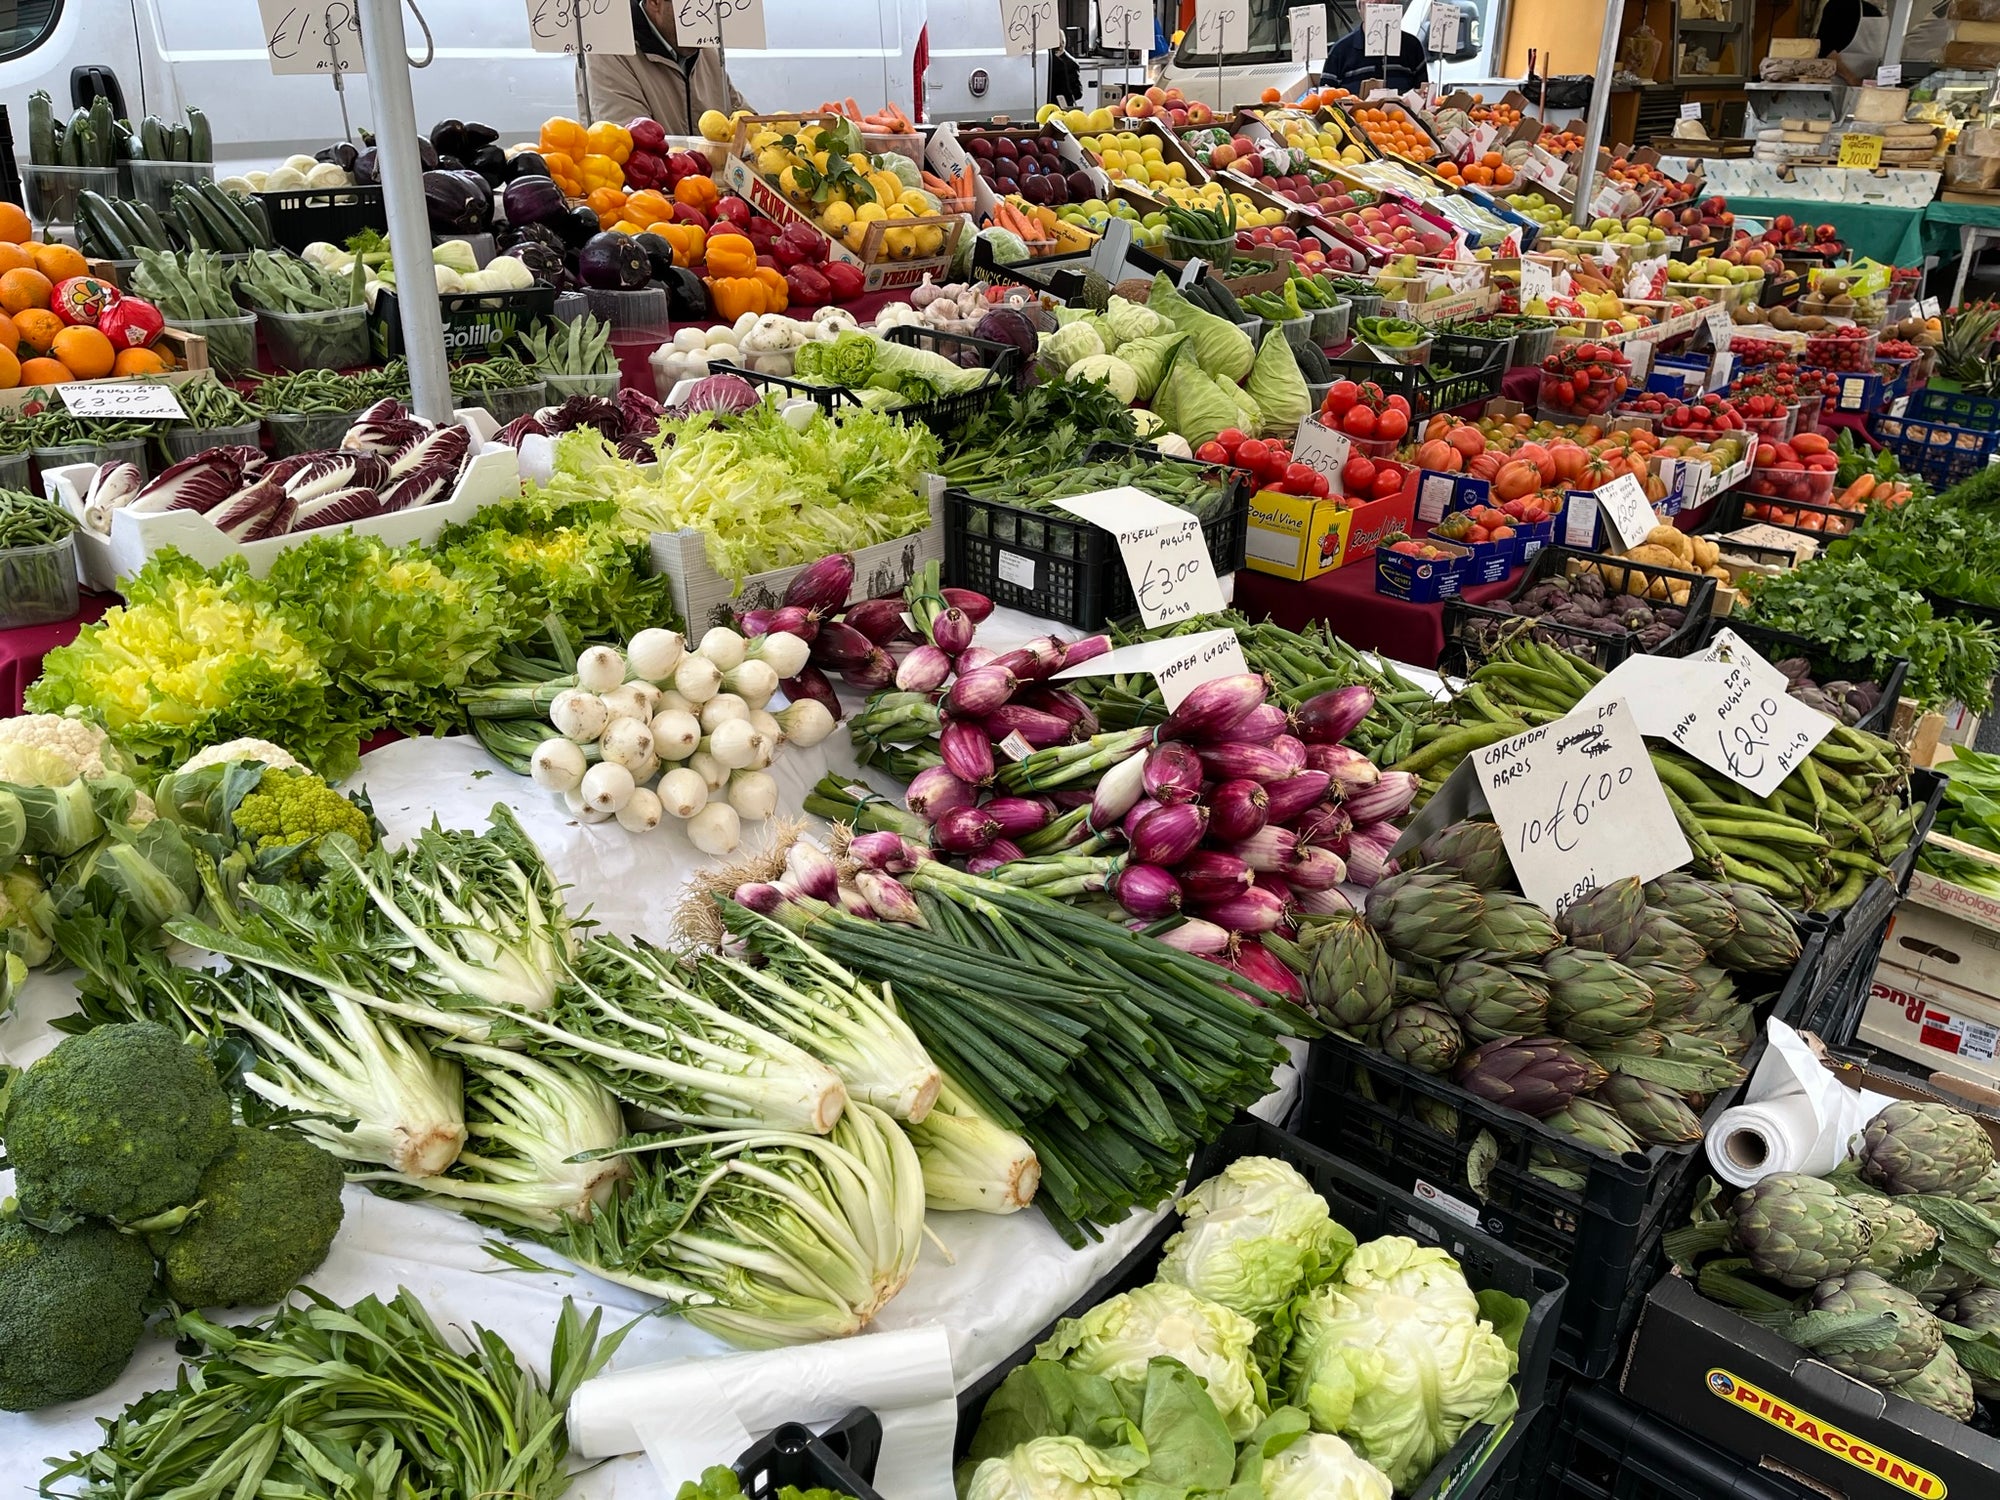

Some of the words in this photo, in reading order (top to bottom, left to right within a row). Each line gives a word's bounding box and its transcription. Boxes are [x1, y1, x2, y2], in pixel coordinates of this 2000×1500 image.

[750, 177, 832, 264] PRIMAA
[443, 323, 504, 348] aolillo
[1119, 526, 1160, 545] PISELLI
[1279, 510, 1303, 528] Vine
[1160, 531, 1193, 550] PUGLIA
[1138, 559, 1200, 611] €3.00
[1159, 655, 1198, 684] TROPEA
[1717, 677, 1751, 720] PUGLIA
[1718, 697, 1778, 779] €2.00
[1493, 757, 1532, 789] AGROS
[1544, 767, 1633, 852] €6.00
[1734, 1386, 1934, 1496] PIRACCINI
